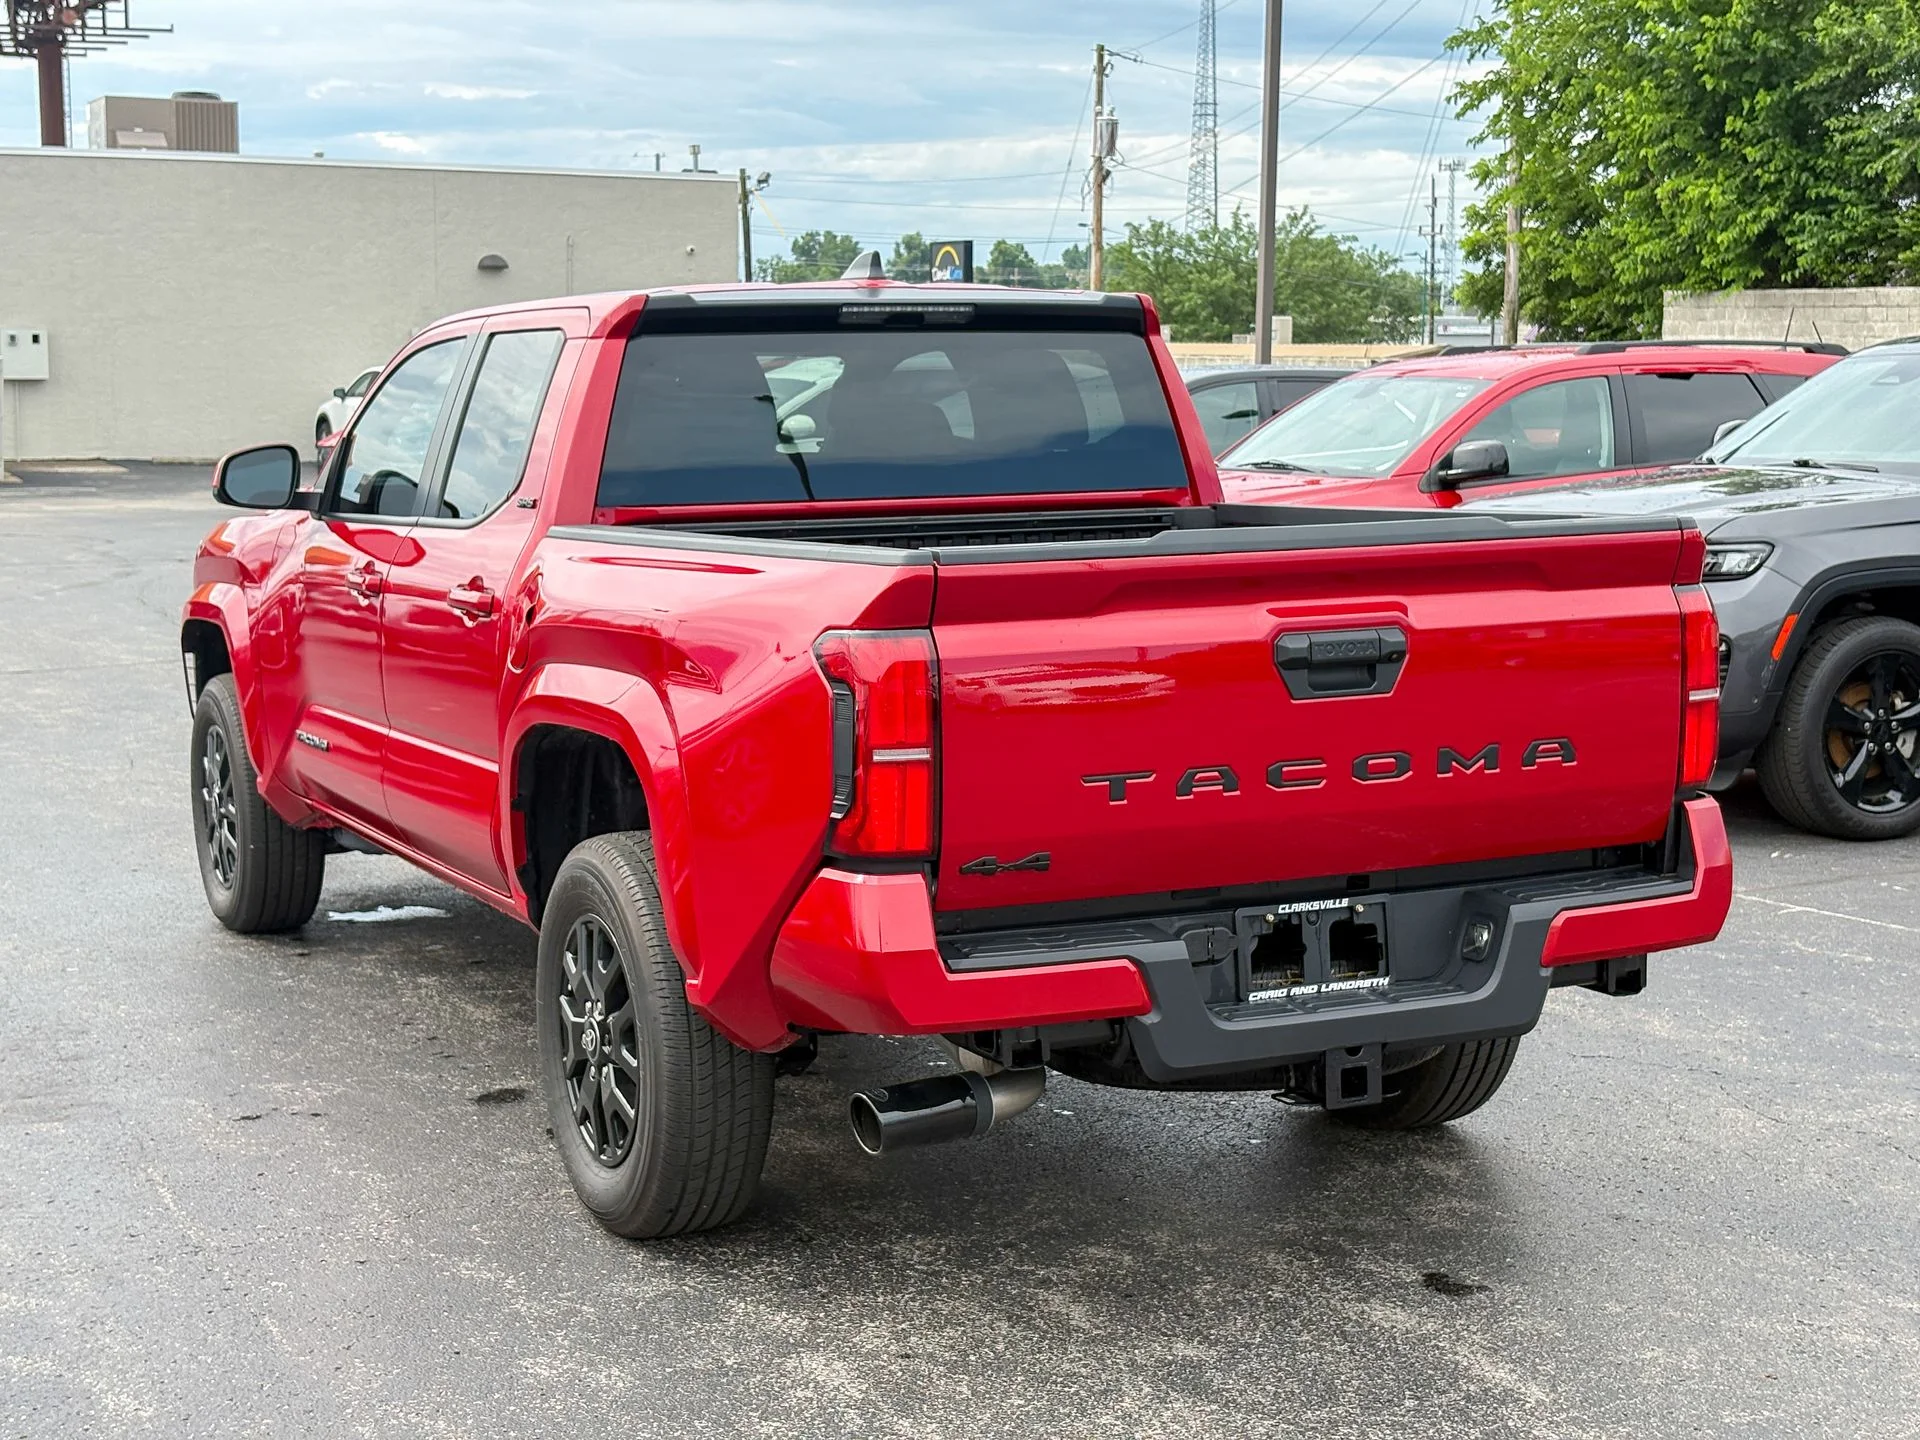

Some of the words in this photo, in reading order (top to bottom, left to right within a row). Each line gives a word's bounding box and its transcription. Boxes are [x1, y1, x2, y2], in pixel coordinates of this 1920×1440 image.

[1313, 640, 1377, 657] TOYOTA
[1081, 737, 1577, 804] TACOMA
[1277, 897, 1350, 915] CLARKSVILLE
[1289, 984, 1318, 996] AND
